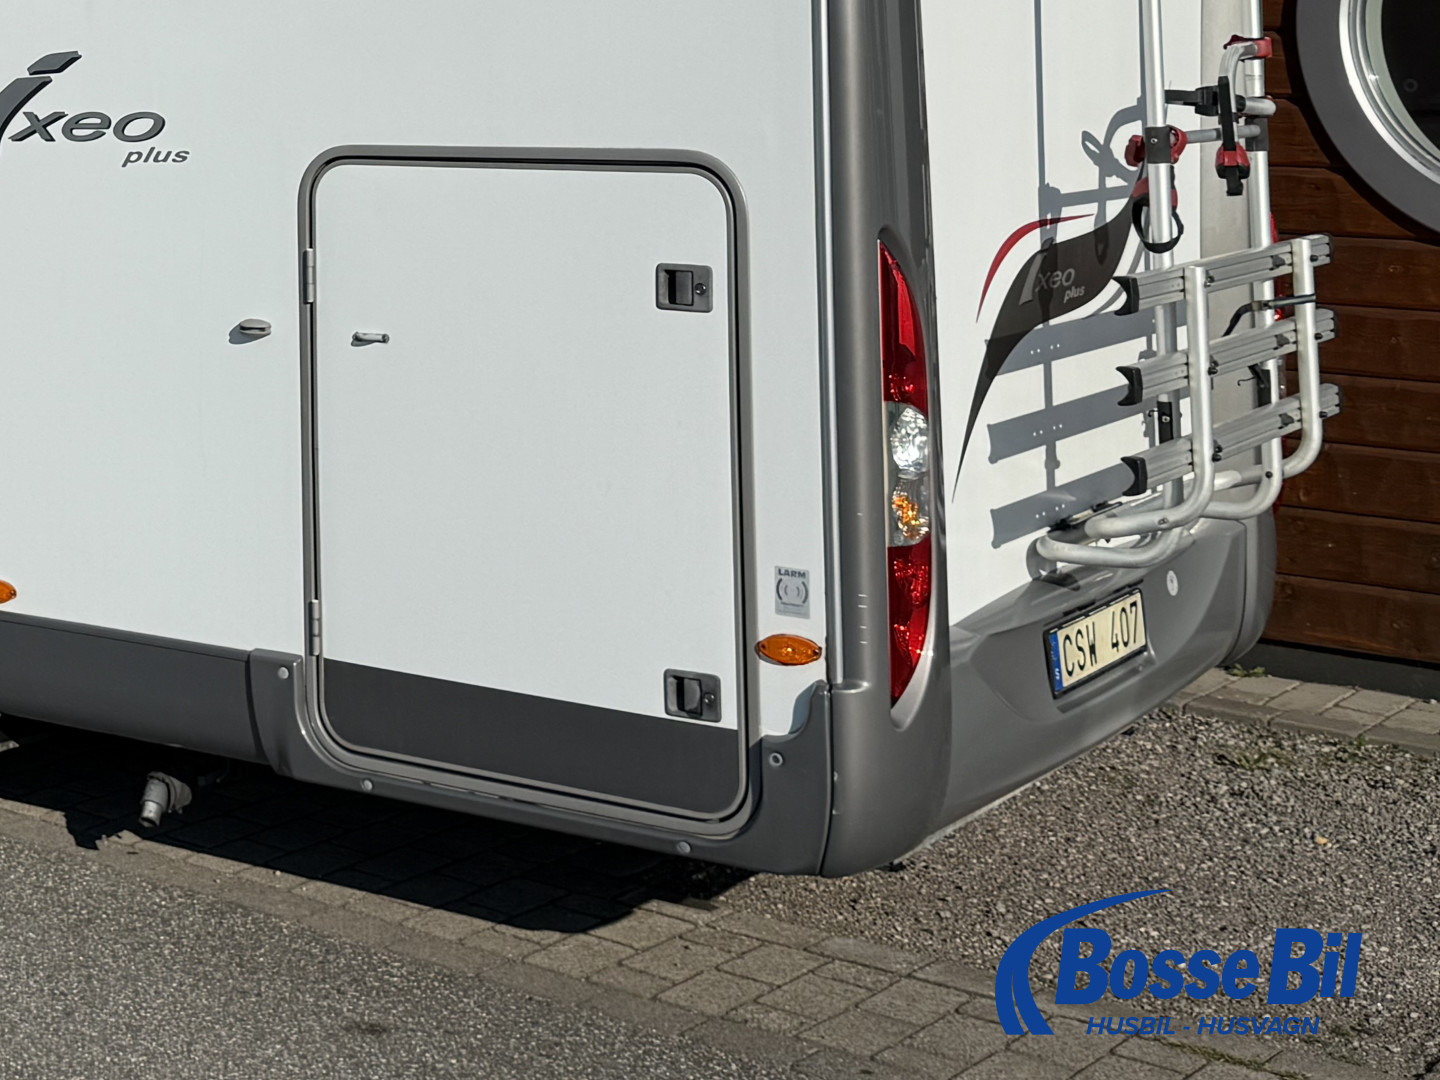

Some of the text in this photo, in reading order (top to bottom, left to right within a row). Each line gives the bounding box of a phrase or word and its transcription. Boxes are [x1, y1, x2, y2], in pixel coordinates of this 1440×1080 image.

[121, 146, 190, 168] plus
[1063, 285, 1086, 304] plus
[777, 567, 807, 580] LARM
[1062, 600, 1138, 678] CSW 407
